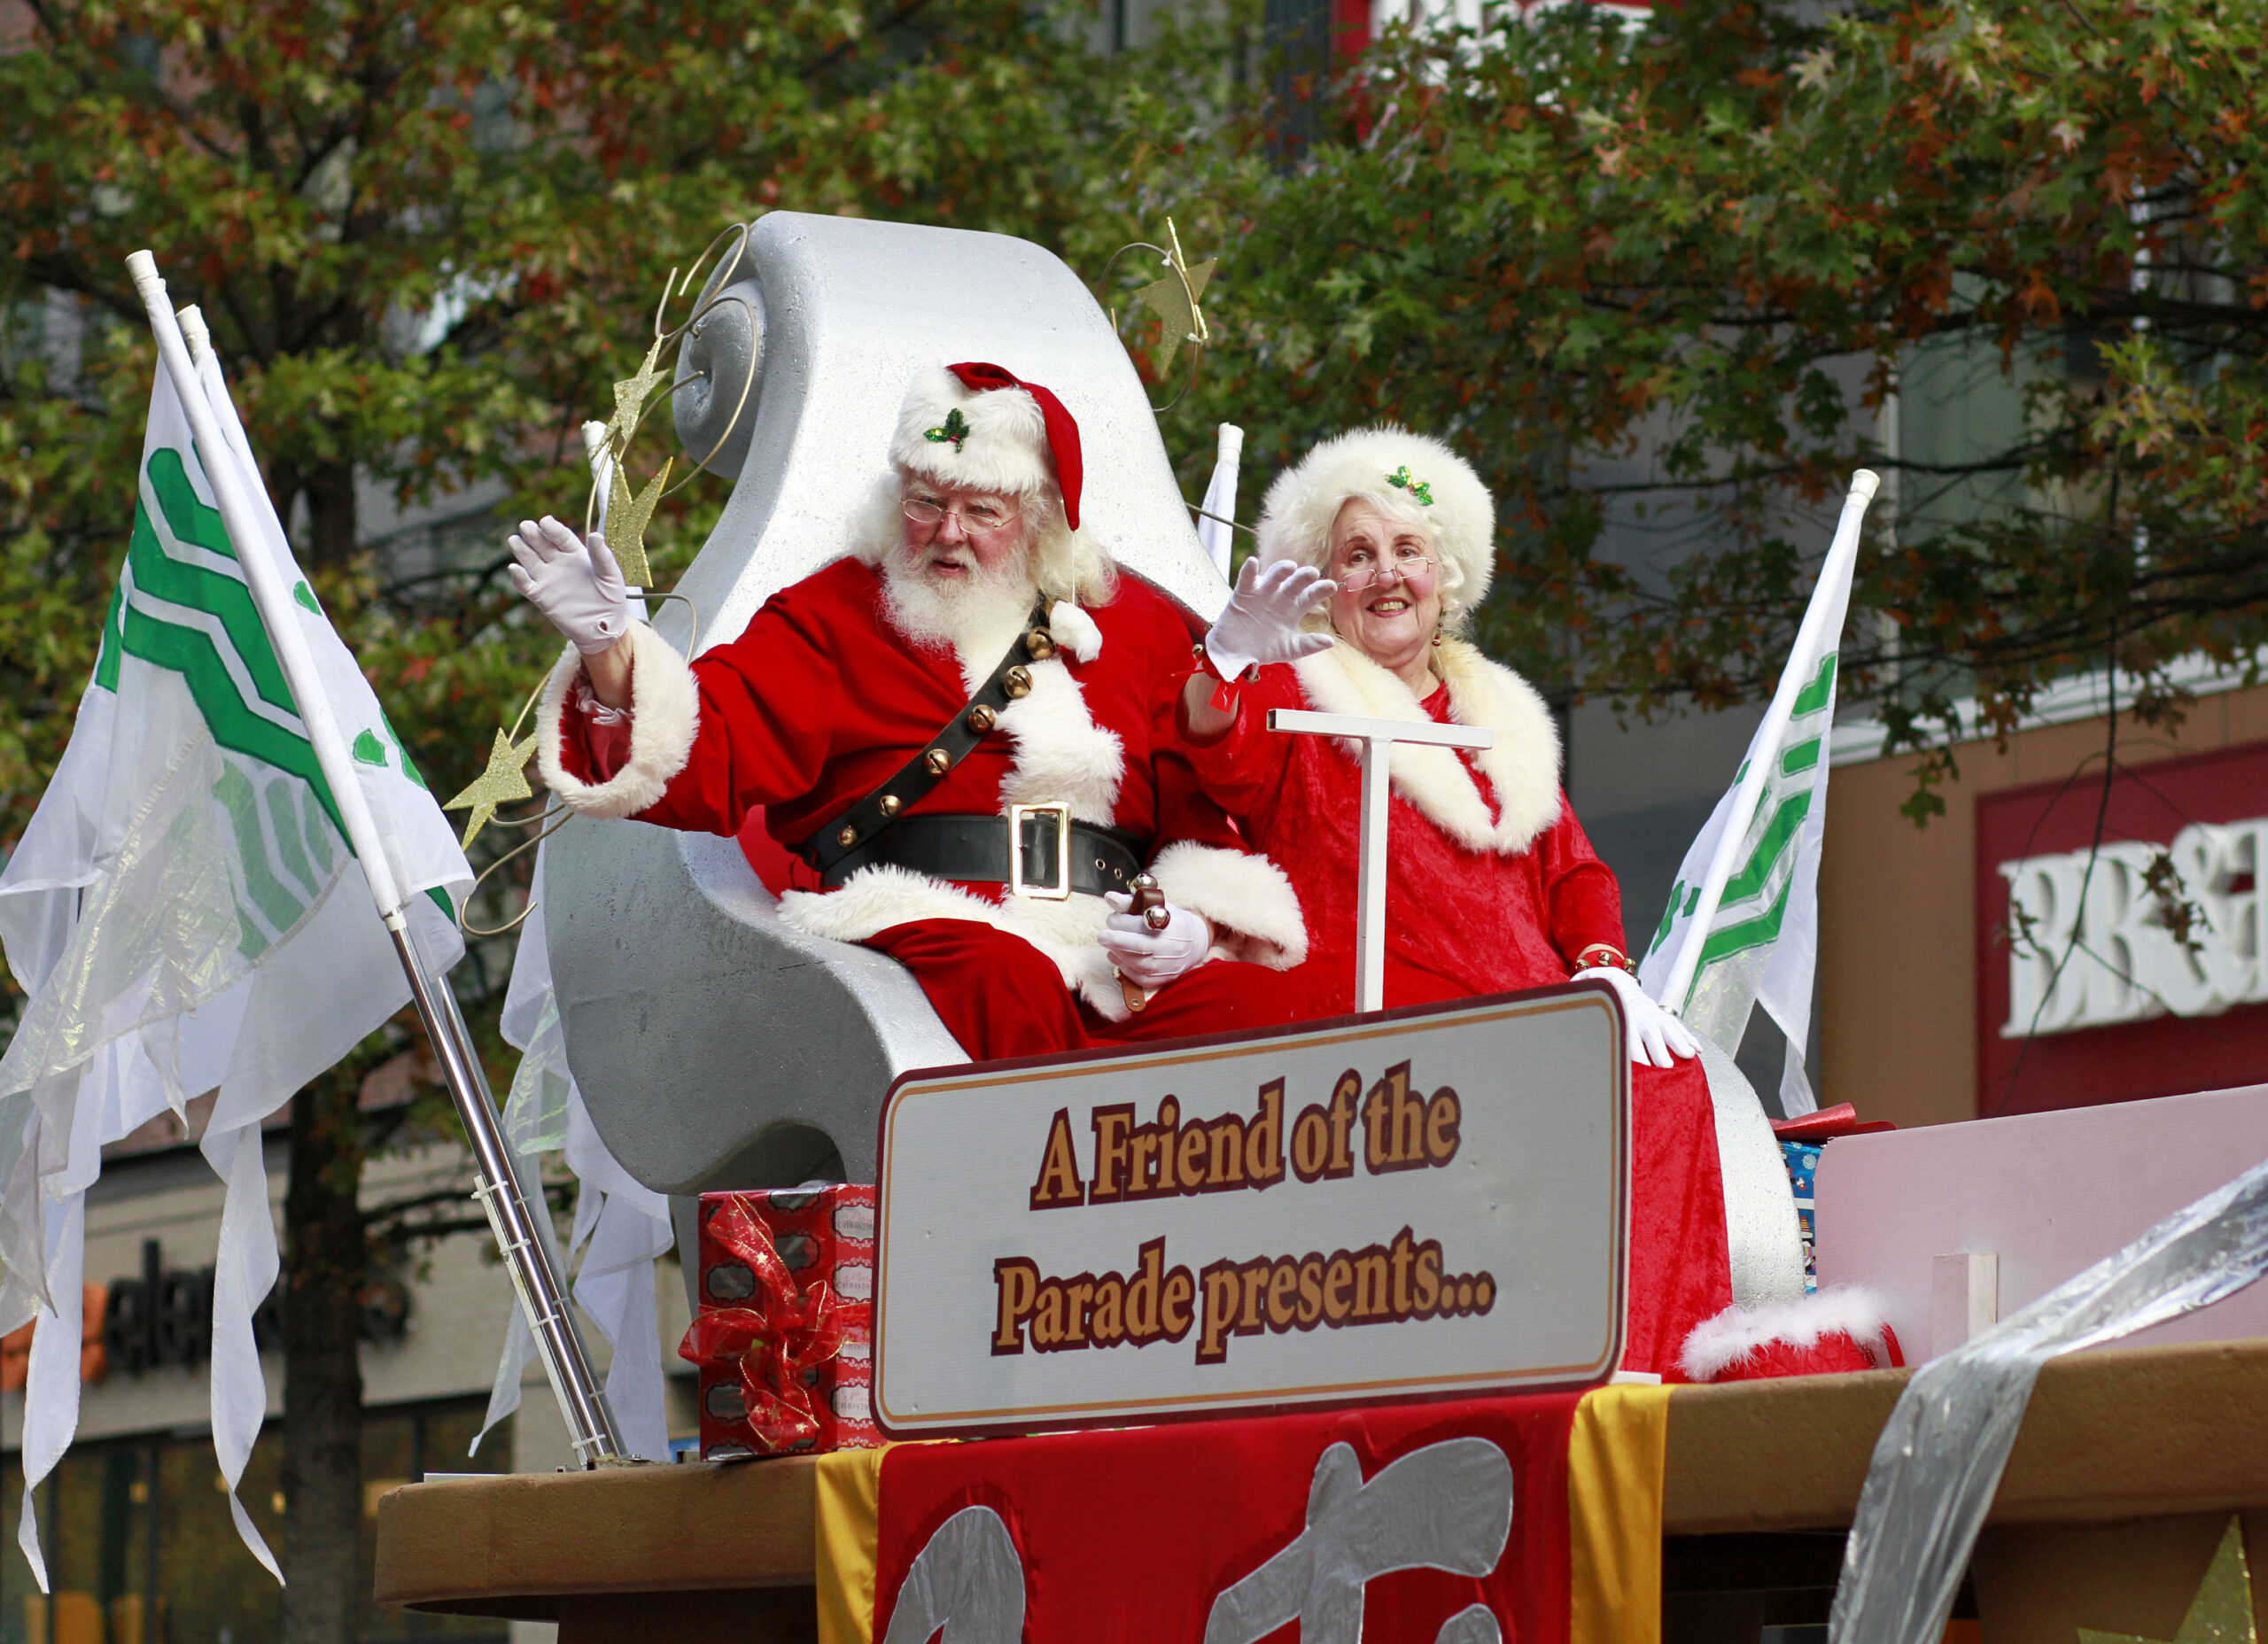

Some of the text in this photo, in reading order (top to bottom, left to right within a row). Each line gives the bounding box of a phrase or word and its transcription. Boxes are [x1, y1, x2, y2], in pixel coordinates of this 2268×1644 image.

[1029, 1059, 1462, 1211] A Friend of the
[990, 1224, 1497, 1365] Parade presents...
